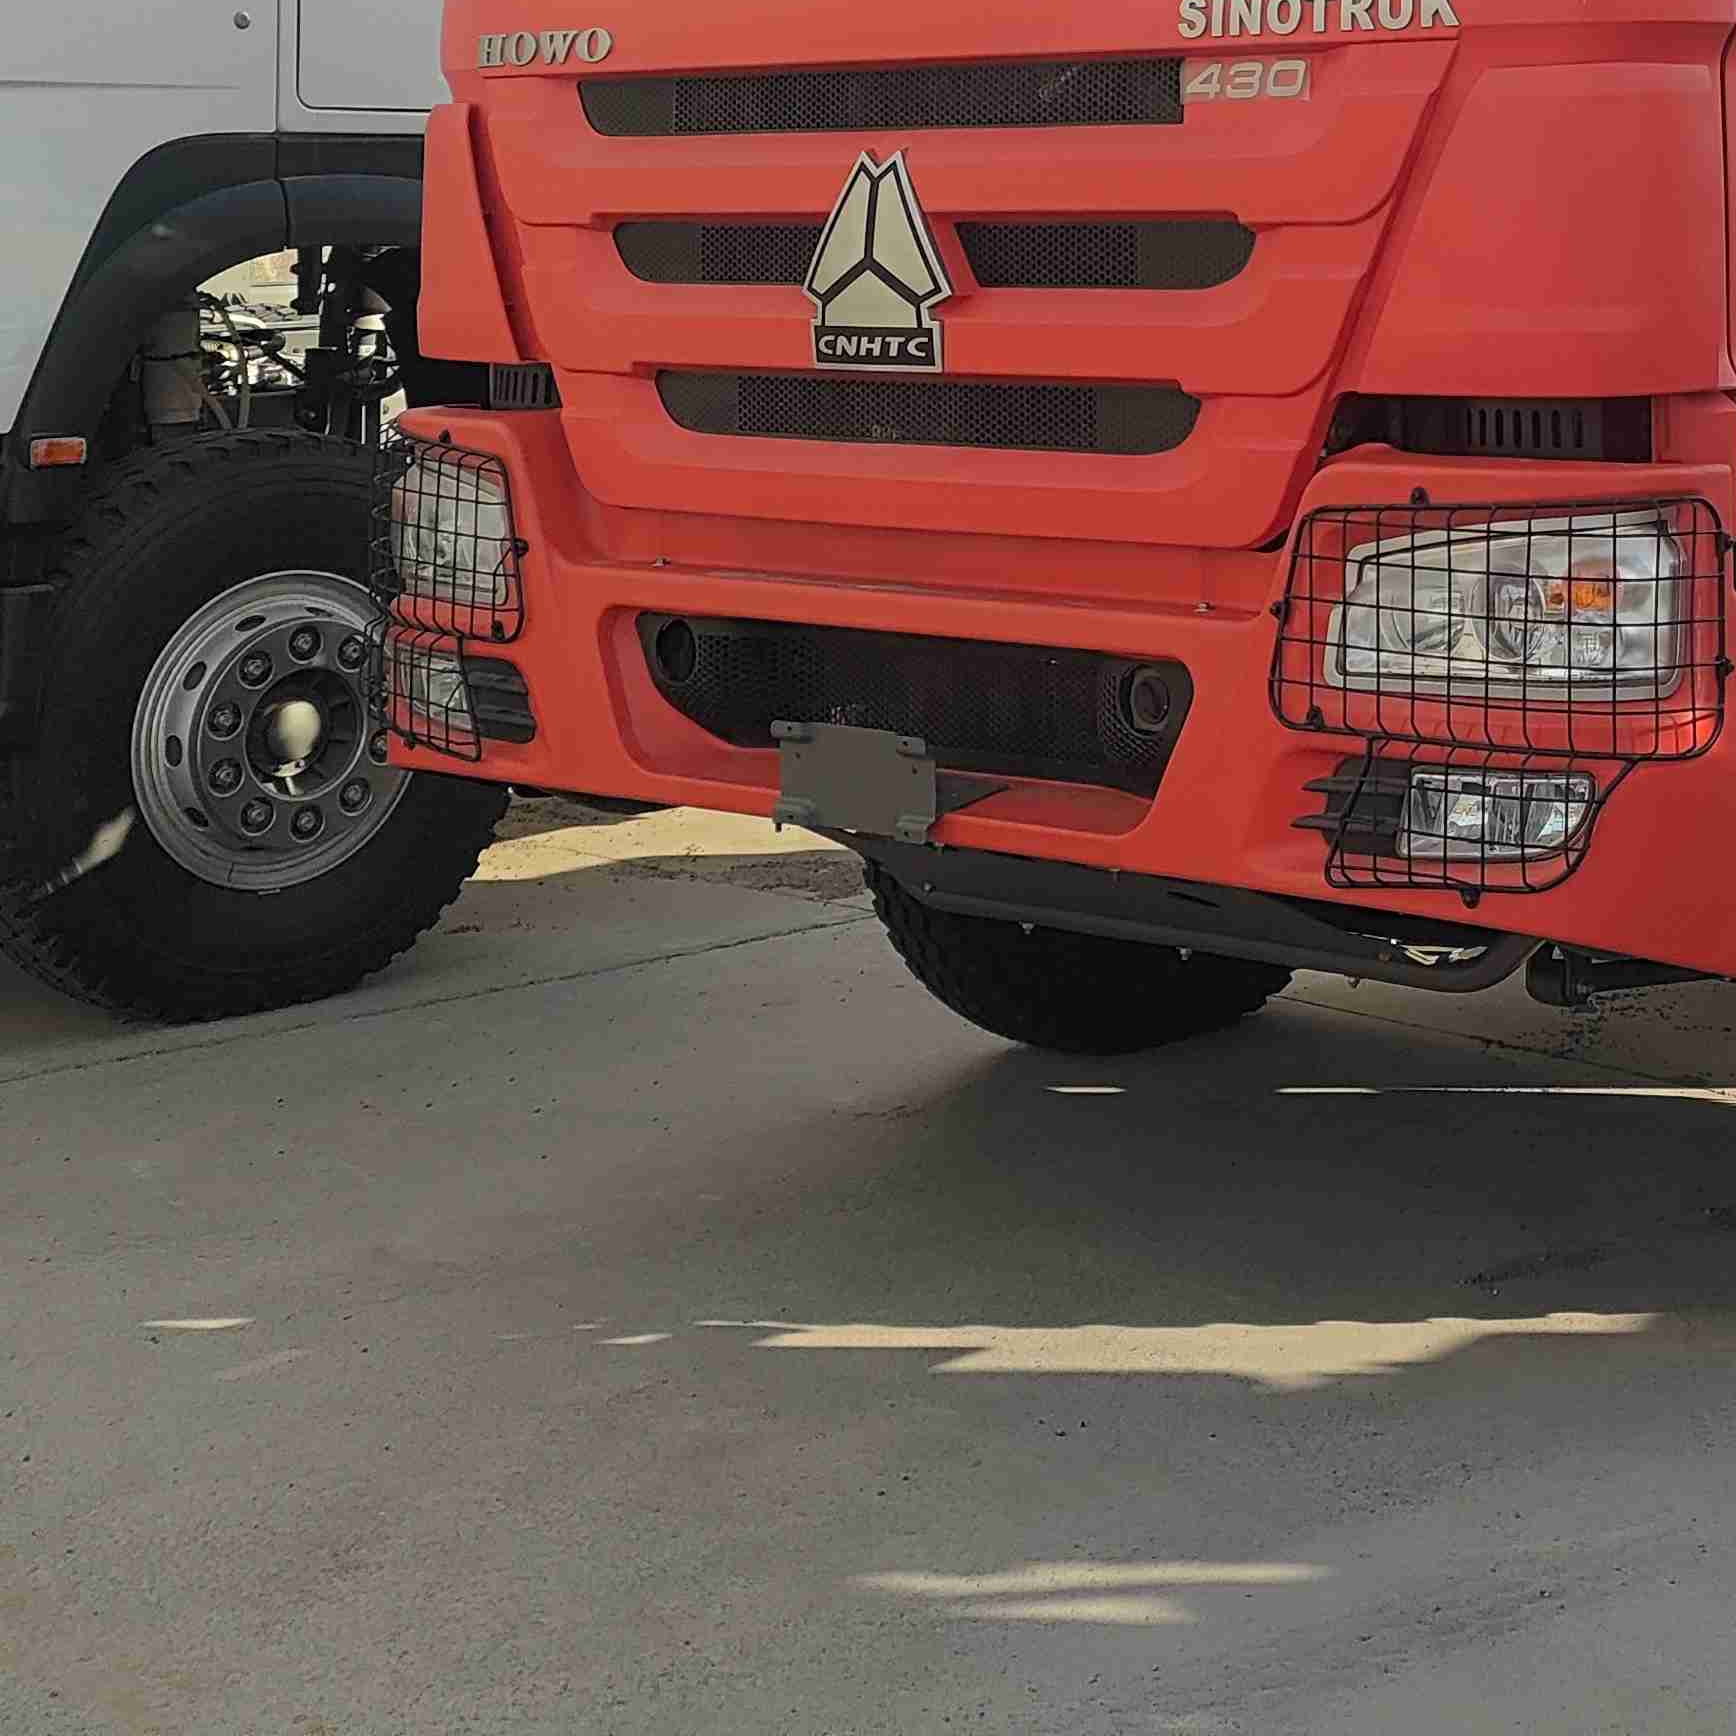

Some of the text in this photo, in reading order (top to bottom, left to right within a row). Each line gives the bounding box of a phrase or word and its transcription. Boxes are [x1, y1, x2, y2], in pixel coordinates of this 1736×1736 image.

[478, 27, 614, 67] HOWO
[1184, 59, 1307, 100] 430
[818, 334, 929, 358] CNHTC
